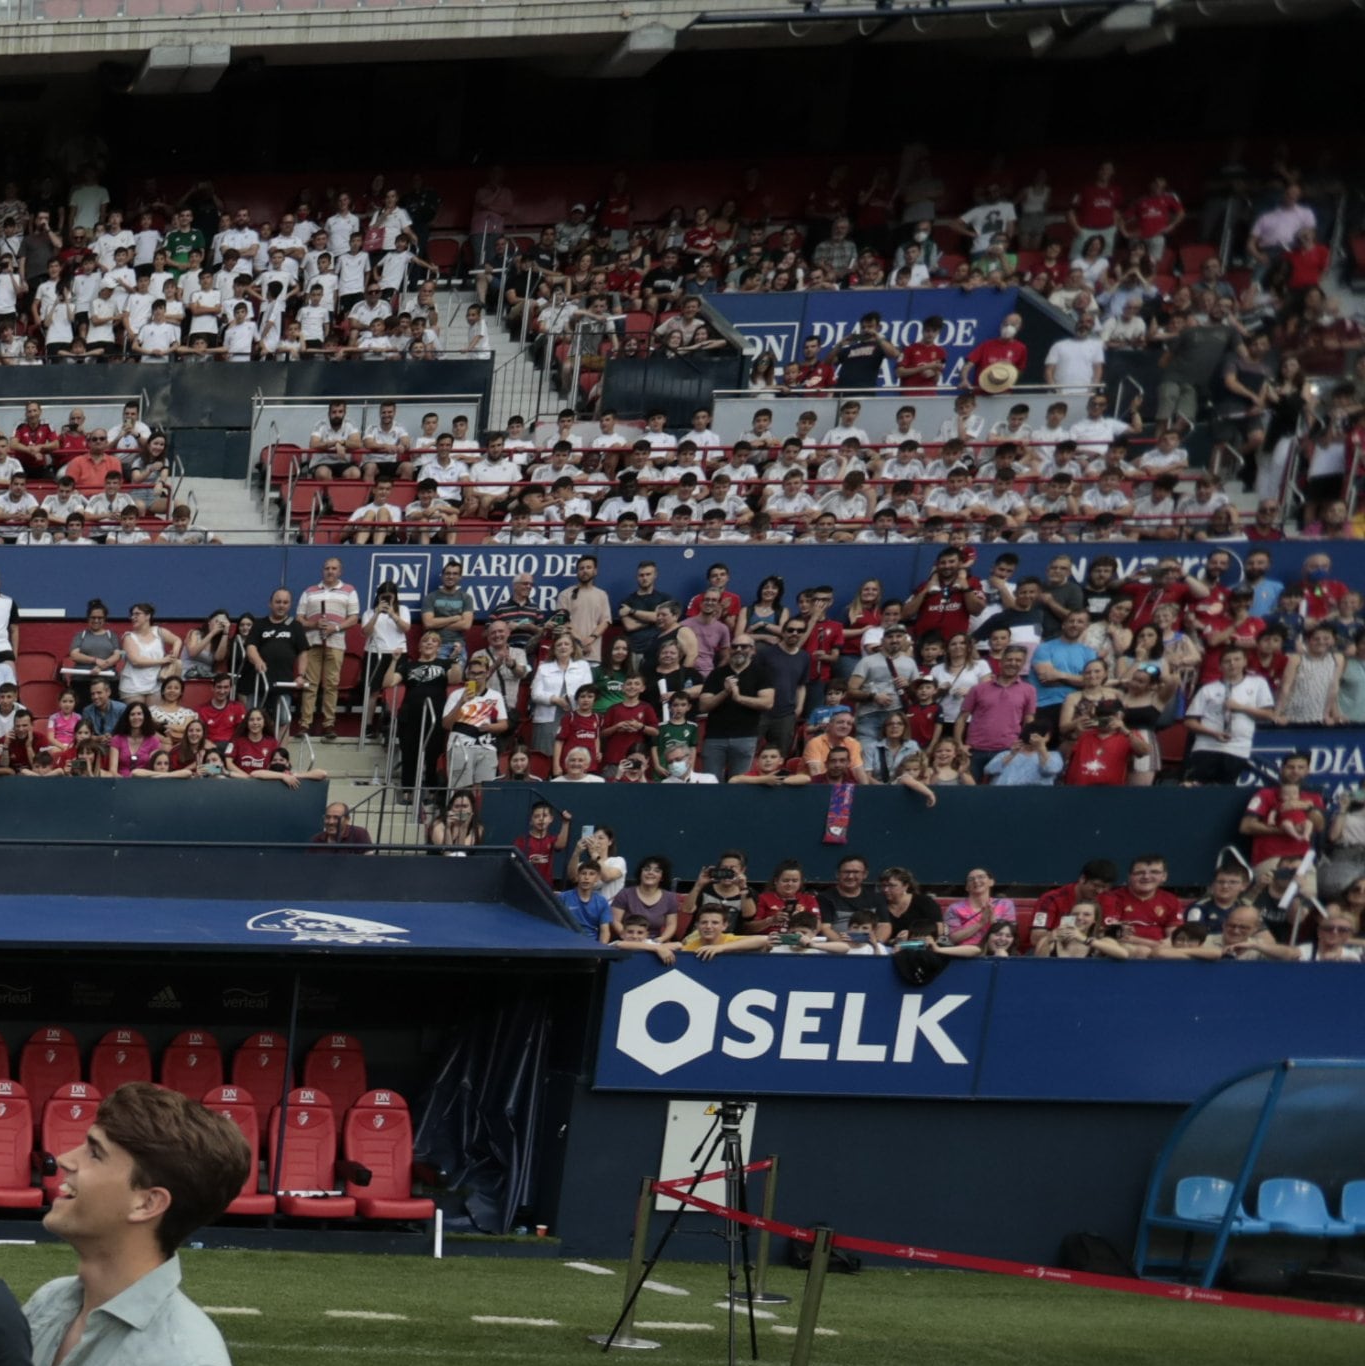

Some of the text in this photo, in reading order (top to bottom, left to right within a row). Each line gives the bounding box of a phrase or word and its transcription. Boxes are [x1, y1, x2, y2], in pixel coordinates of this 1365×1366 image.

[542, 553, 583, 577] DE
[376, 562, 422, 589] DN
[721, 988, 972, 1064] SELK
[46, 1029, 61, 1038] DN
[117, 1031, 132, 1040] DN
[189, 1033, 203, 1042] DN
[259, 1035, 273, 1044] DN
[332, 1036, 346, 1045] DN
[70, 1085, 86, 1094] DN
[222, 1089, 237, 1098] DN
[300, 1091, 315, 1100] DN
[375, 1093, 390, 1102] DN
